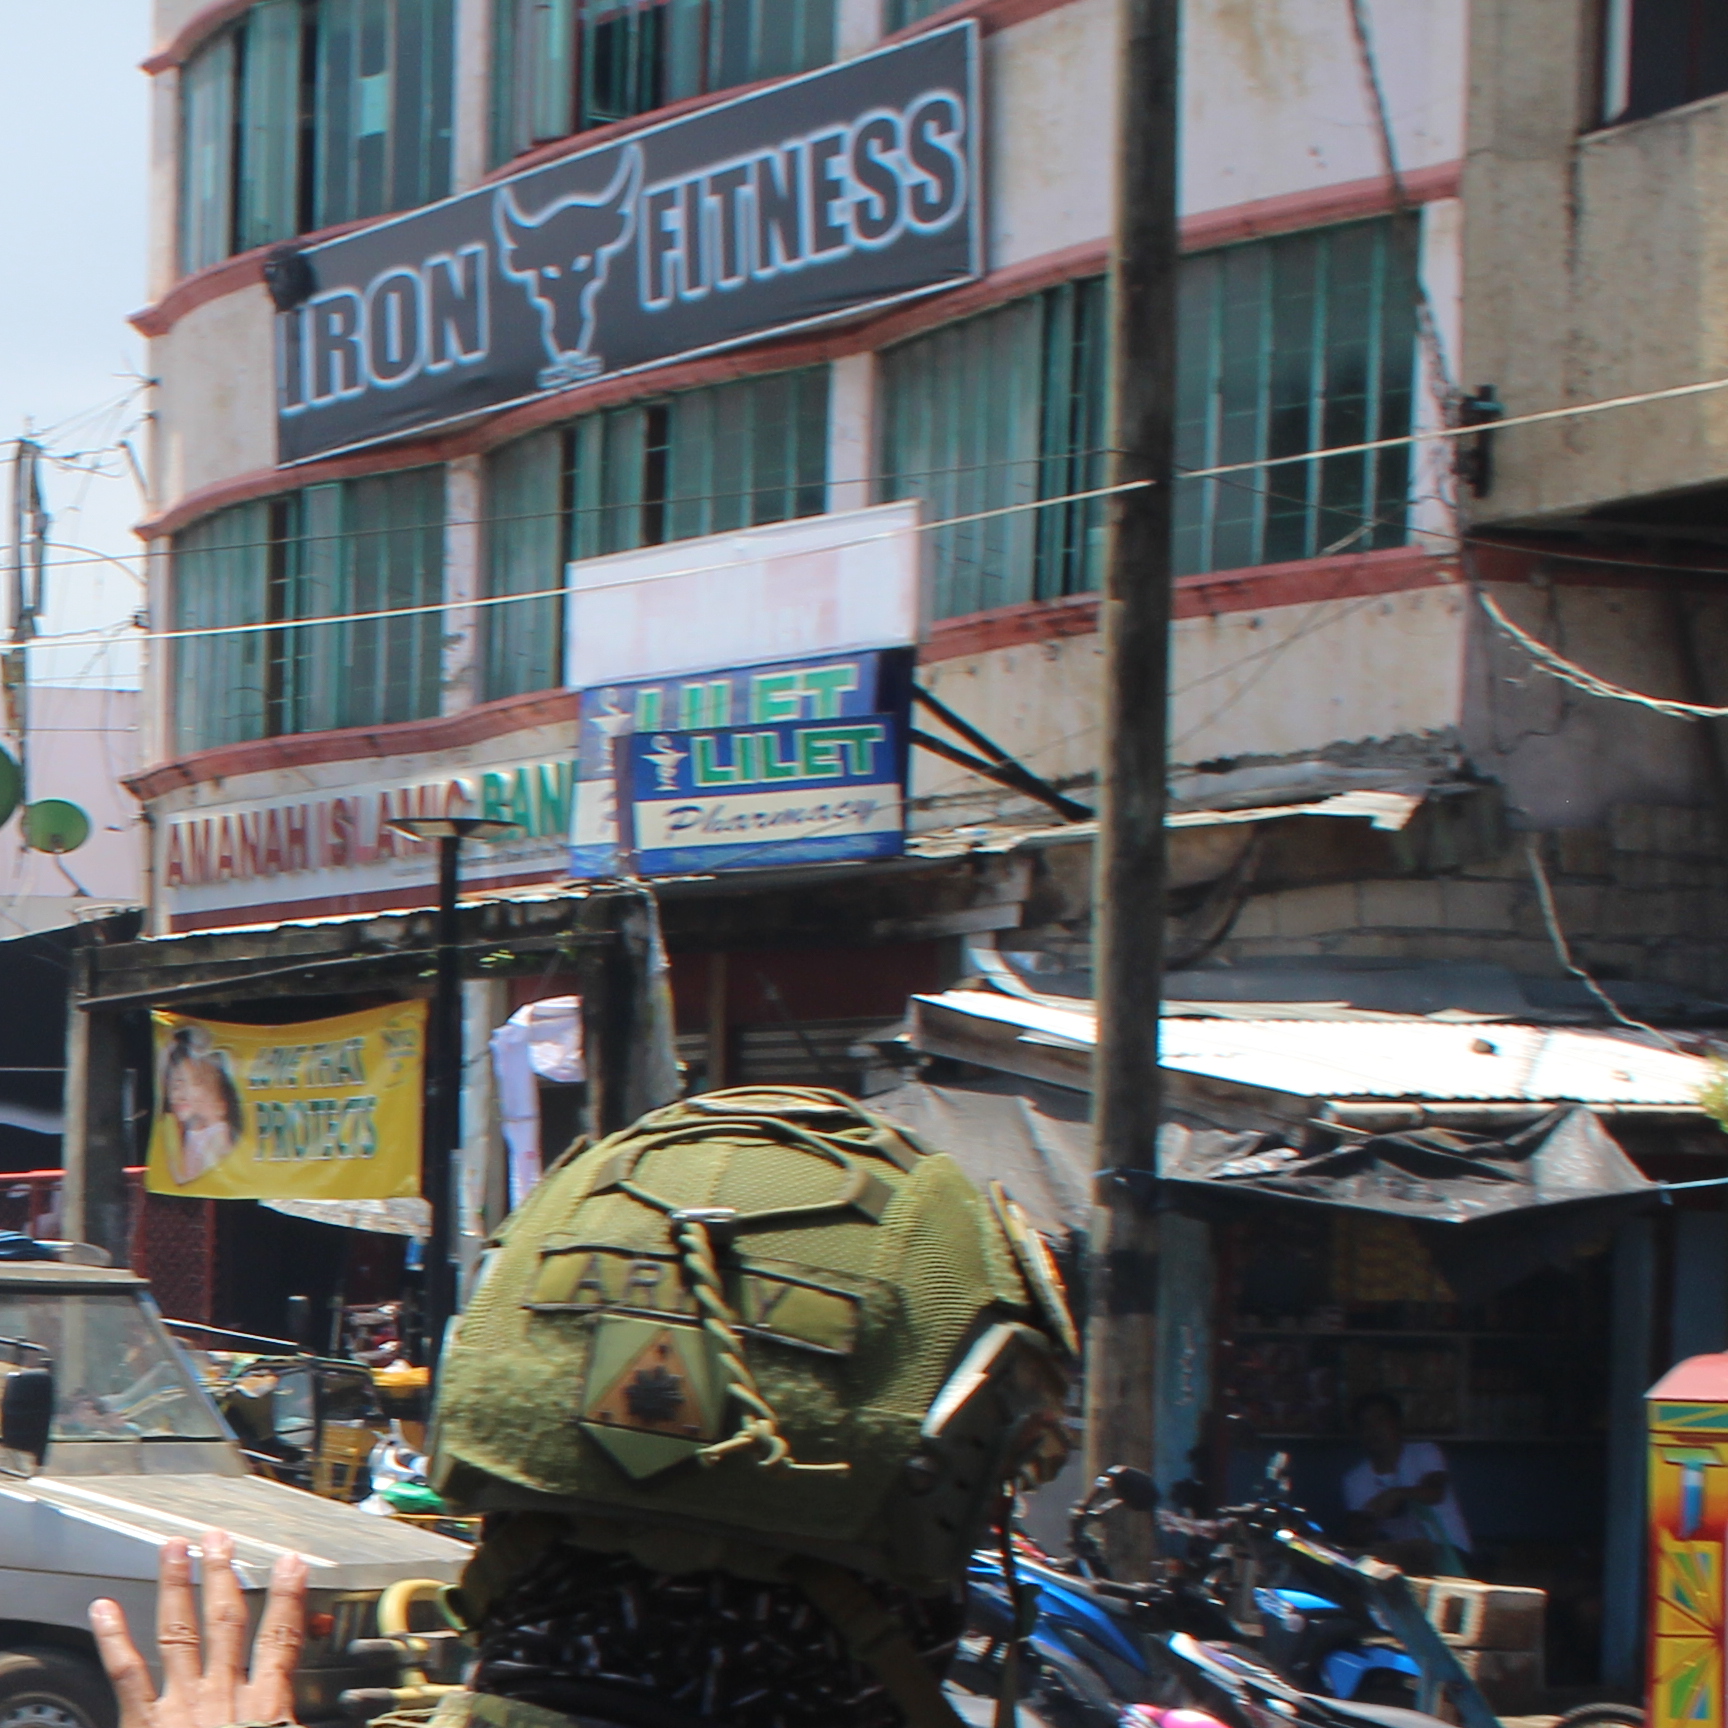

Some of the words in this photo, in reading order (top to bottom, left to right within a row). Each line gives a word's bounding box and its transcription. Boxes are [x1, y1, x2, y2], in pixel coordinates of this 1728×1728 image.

[275, 241, 489, 417] IRON
[636, 89, 968, 310] FITNESS
[691, 724, 885, 787] LILET
[166, 802, 310, 887] AMANAH
[481, 759, 579, 843] BAN
[663, 799, 877, 840] Pharmacy
[306, 1036, 366, 1087] THAT
[253, 1096, 378, 1161] PROTECTS
[572, 1251, 788, 1328] ARY
